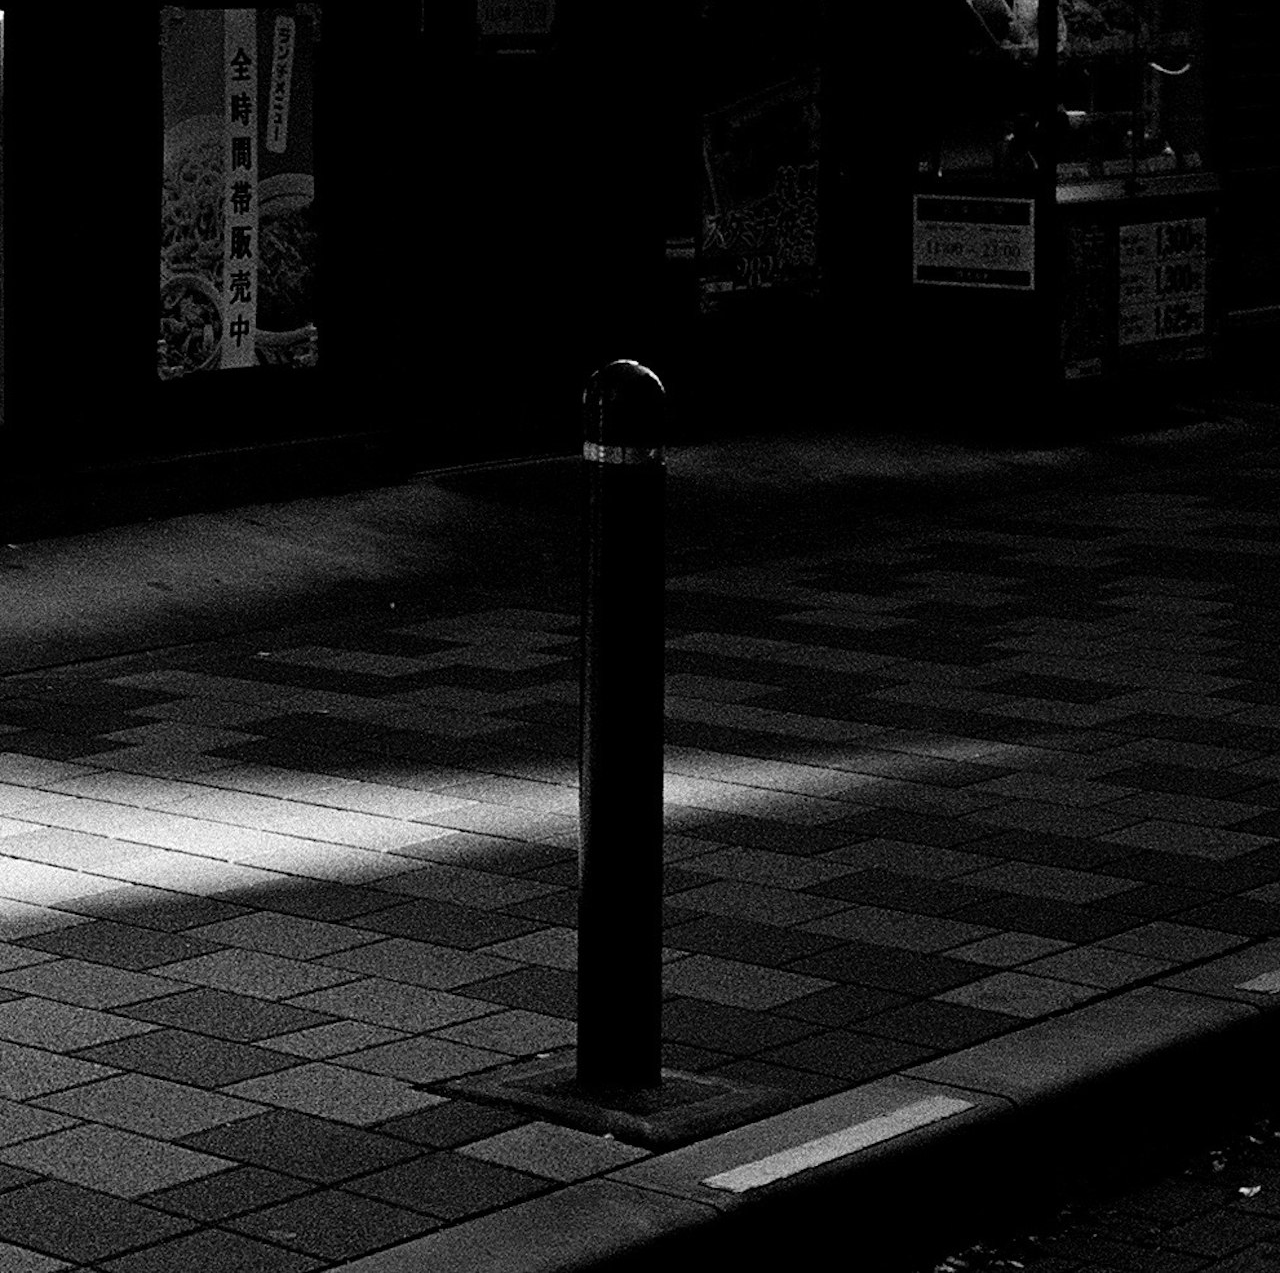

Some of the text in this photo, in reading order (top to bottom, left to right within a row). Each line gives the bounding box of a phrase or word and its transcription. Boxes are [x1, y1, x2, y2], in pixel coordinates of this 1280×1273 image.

[229, 46, 254, 348] 全時間帯販売中
